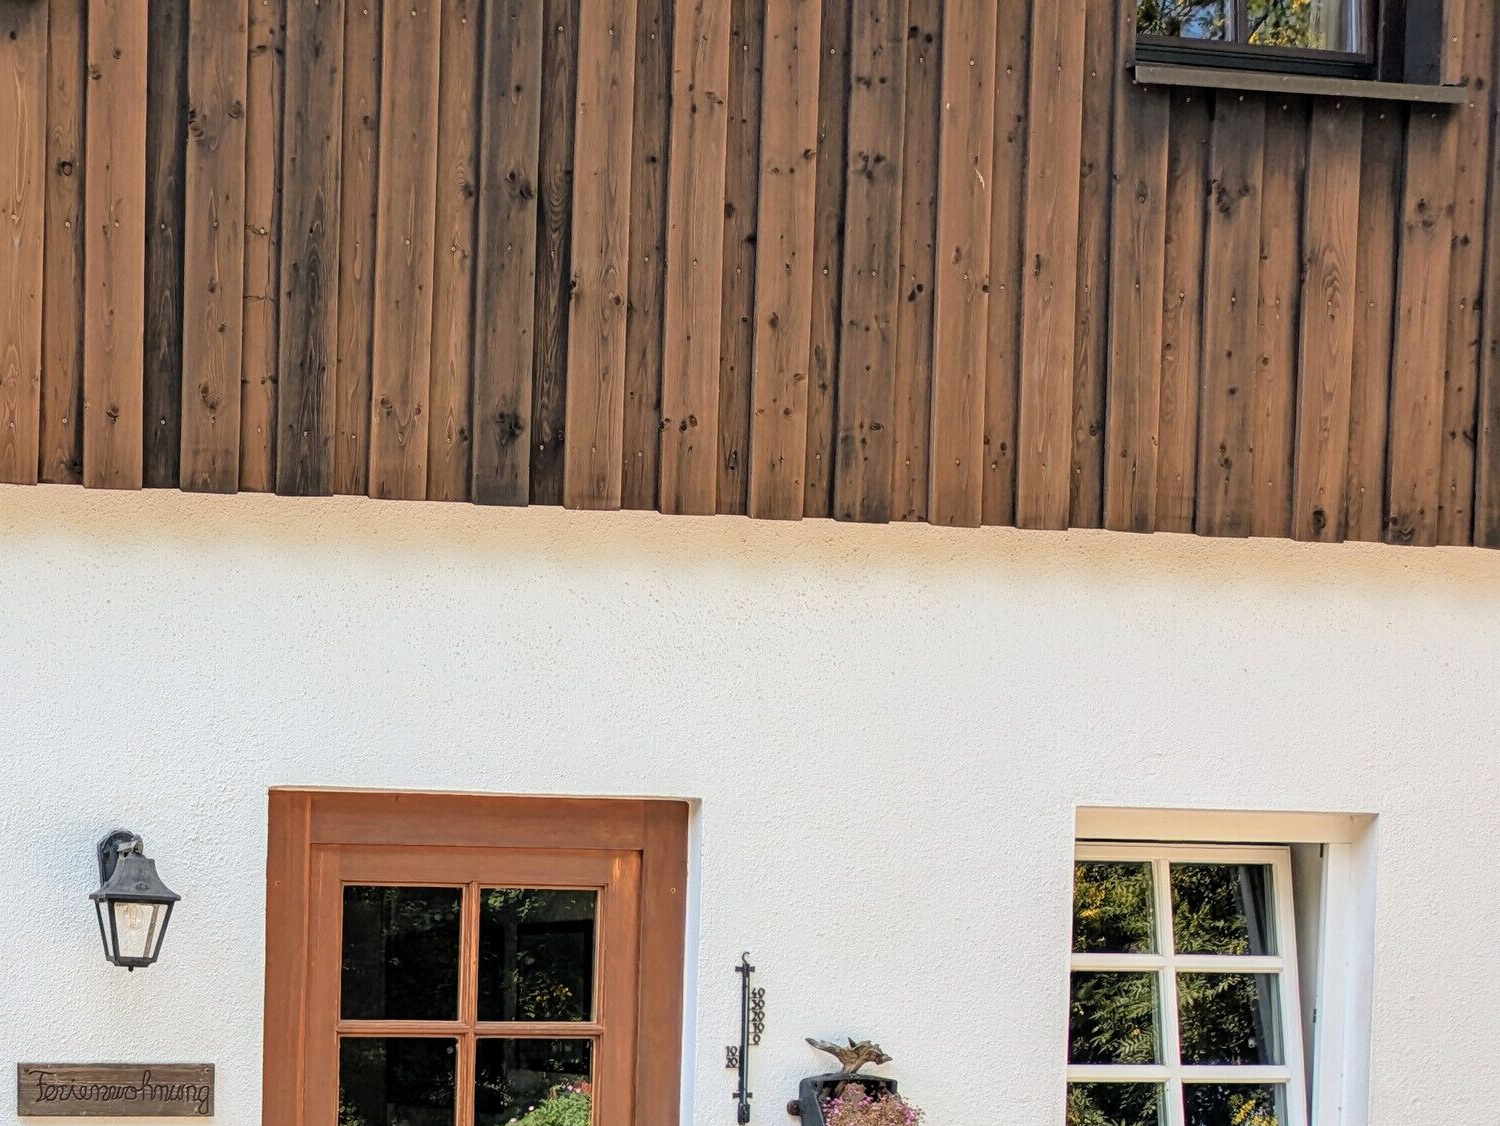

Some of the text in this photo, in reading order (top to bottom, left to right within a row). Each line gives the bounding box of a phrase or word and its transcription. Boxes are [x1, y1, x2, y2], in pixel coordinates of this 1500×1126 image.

[752, 1022, 765, 1033] 10
[725, 1045, 738, 1056] 10
[29, 1069, 210, 1115] Ferienwohnung
